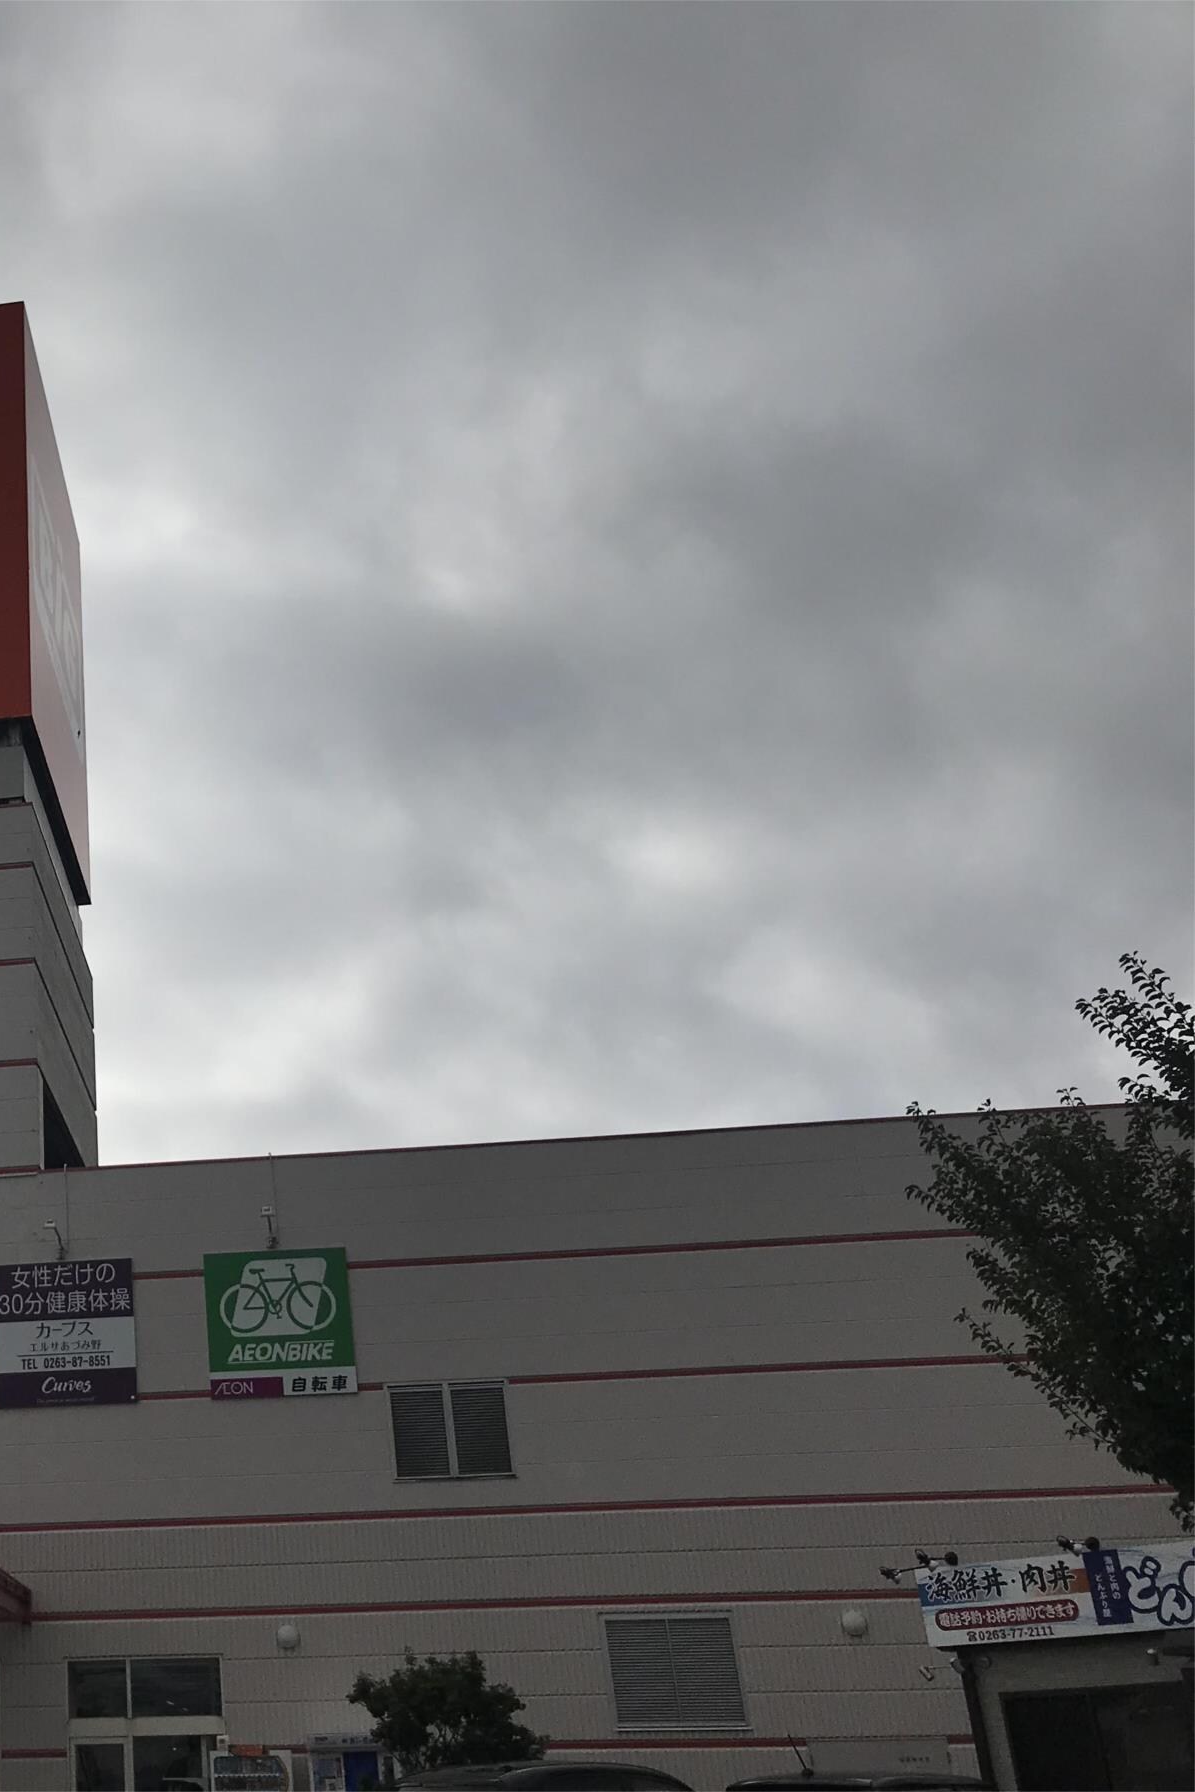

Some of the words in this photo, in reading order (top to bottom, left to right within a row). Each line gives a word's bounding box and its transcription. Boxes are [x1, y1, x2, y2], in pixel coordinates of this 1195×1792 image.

[11, 1262, 117, 1290] 女性だけの
[227, 1339, 336, 1365] AEONBIKE
[22, 1358, 39, 1371] TEL
[43, 1354, 112, 1370] 0263-87-8551
[40, 1375, 93, 1395] Curves
[291, 1374, 349, 1393] 自転車
[1123, 1556, 1195, 1627] どん
[978, 1626, 1055, 1642] 0263-77-2111
